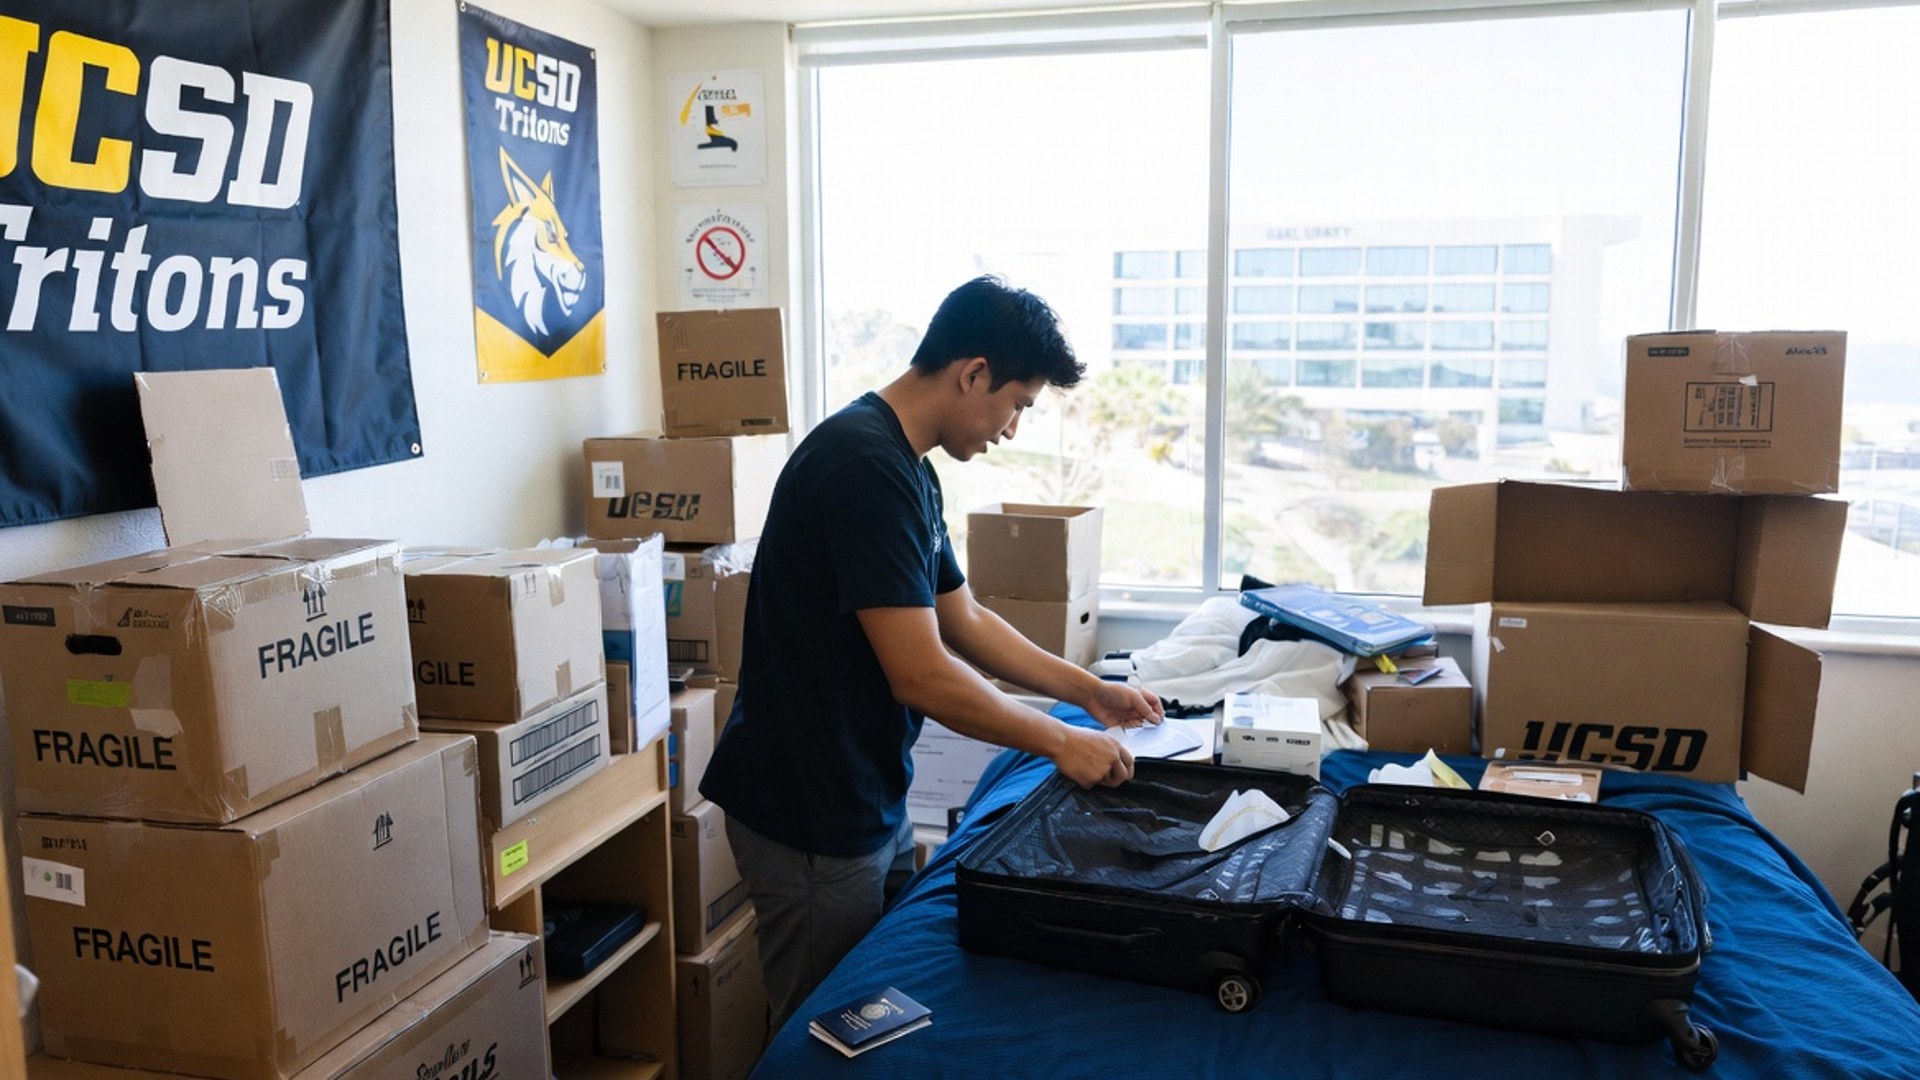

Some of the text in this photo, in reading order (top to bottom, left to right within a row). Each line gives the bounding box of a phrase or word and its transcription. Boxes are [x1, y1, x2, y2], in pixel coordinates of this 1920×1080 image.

[485, 37, 581, 113] UCSD
[495, 97, 571, 146] Tritons
[677, 359, 767, 381] FRAGILE
[258, 612, 375, 679] FRAGILE
[417, 660, 476, 687] GILE
[33, 729, 177, 771] FRAGILE
[1517, 720, 1708, 772] UCSD
[73, 926, 215, 972] FRAGILE
[335, 911, 442, 1003] FRAGILE
